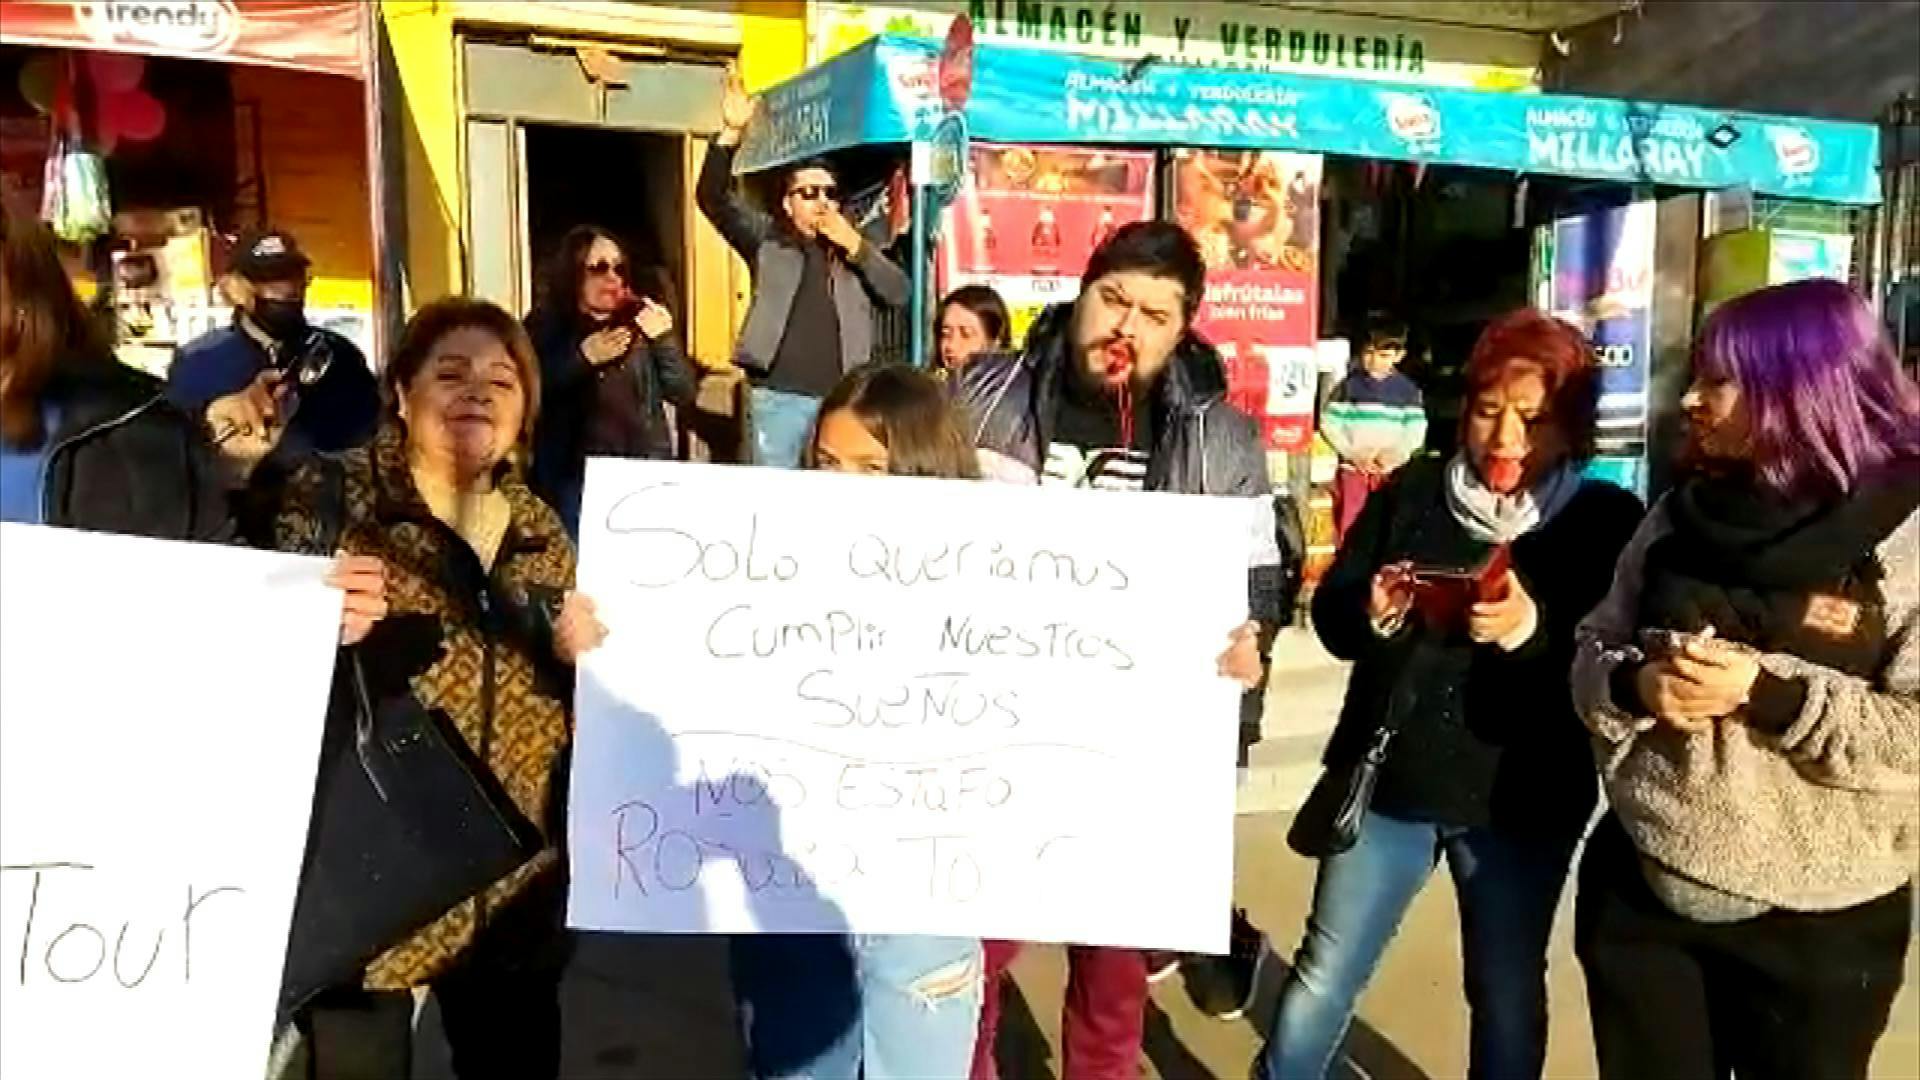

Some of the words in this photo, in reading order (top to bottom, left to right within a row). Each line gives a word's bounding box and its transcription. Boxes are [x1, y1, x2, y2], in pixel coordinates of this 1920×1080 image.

[969, 1, 1141, 47] ALMACÉN
[1174, 17, 1192, 52] Y
[1220, 22, 1425, 74] VERDULERÍA
[1527, 128, 1706, 179] MILLARAY
[0, 861, 246, 989] Tour
